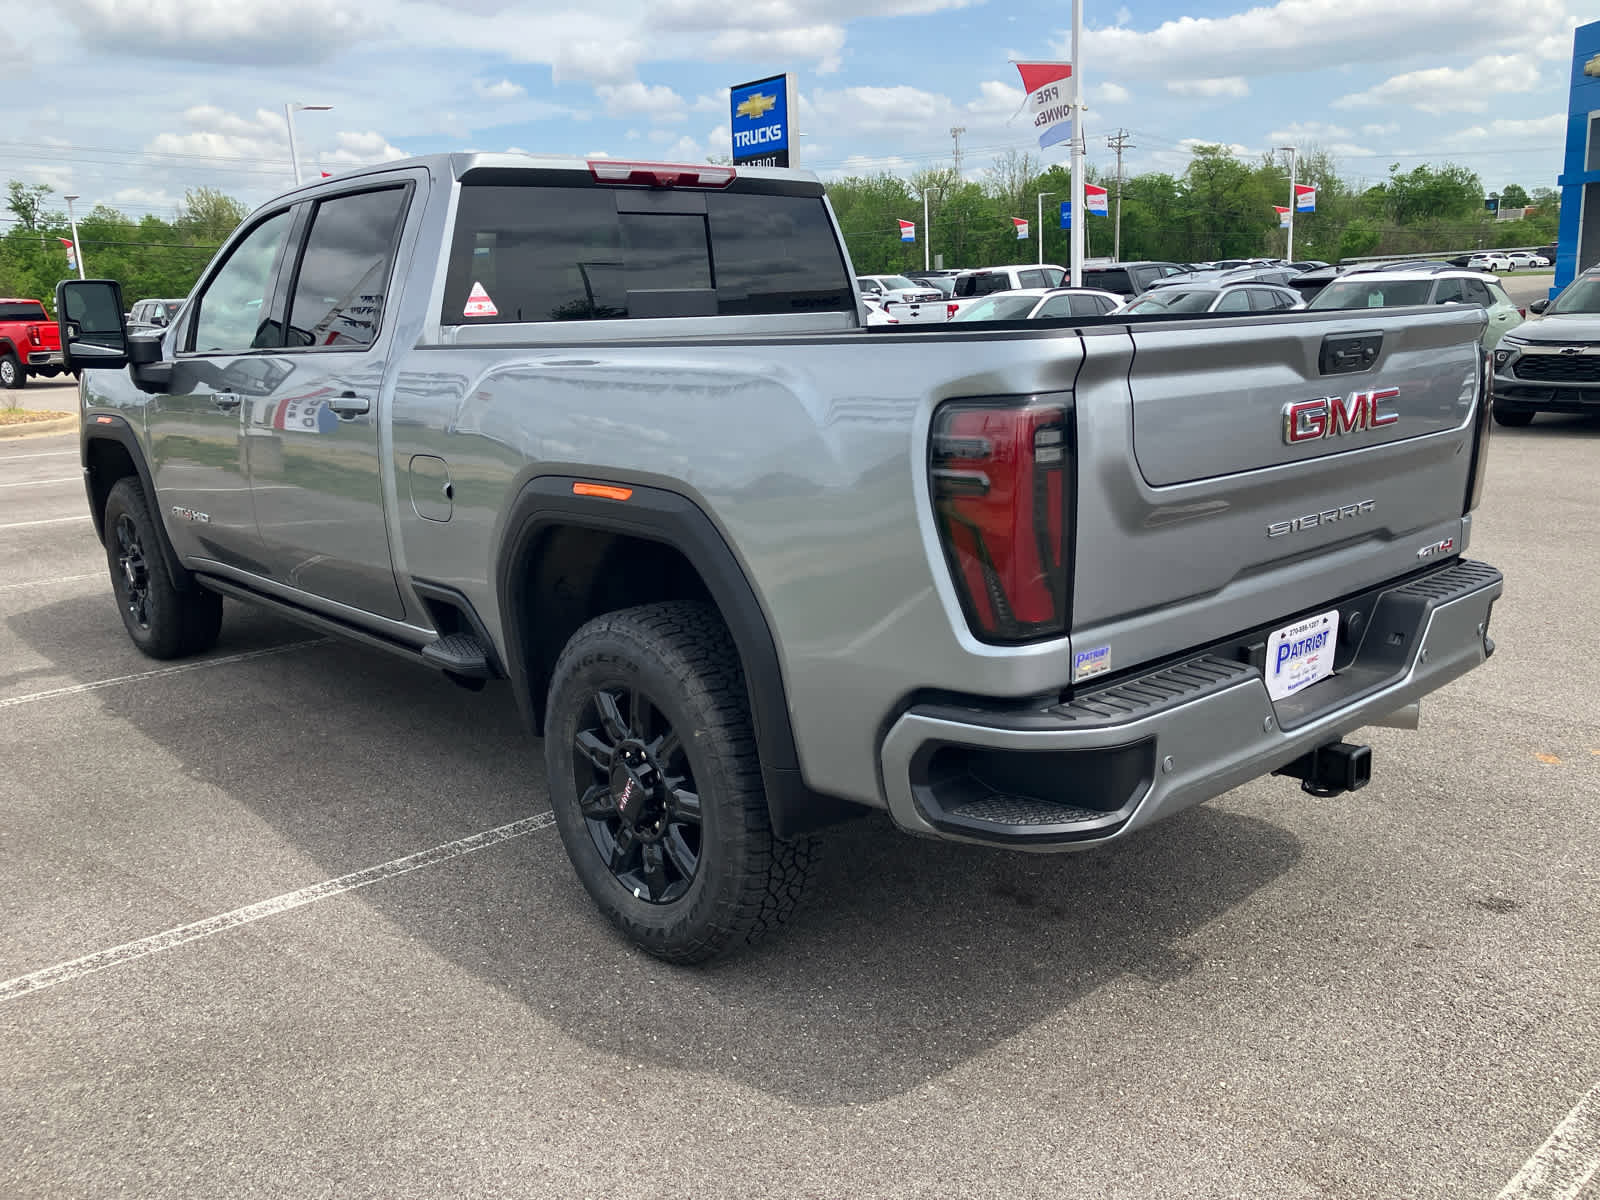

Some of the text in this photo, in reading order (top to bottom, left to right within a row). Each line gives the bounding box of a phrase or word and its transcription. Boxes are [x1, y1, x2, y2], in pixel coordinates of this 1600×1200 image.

[734, 124, 781, 147] TRUCKS
[1282, 387, 1400, 445] GMC
[1266, 500, 1376, 538] SIERRA
[1276, 630, 1329, 674] PATRIOT
